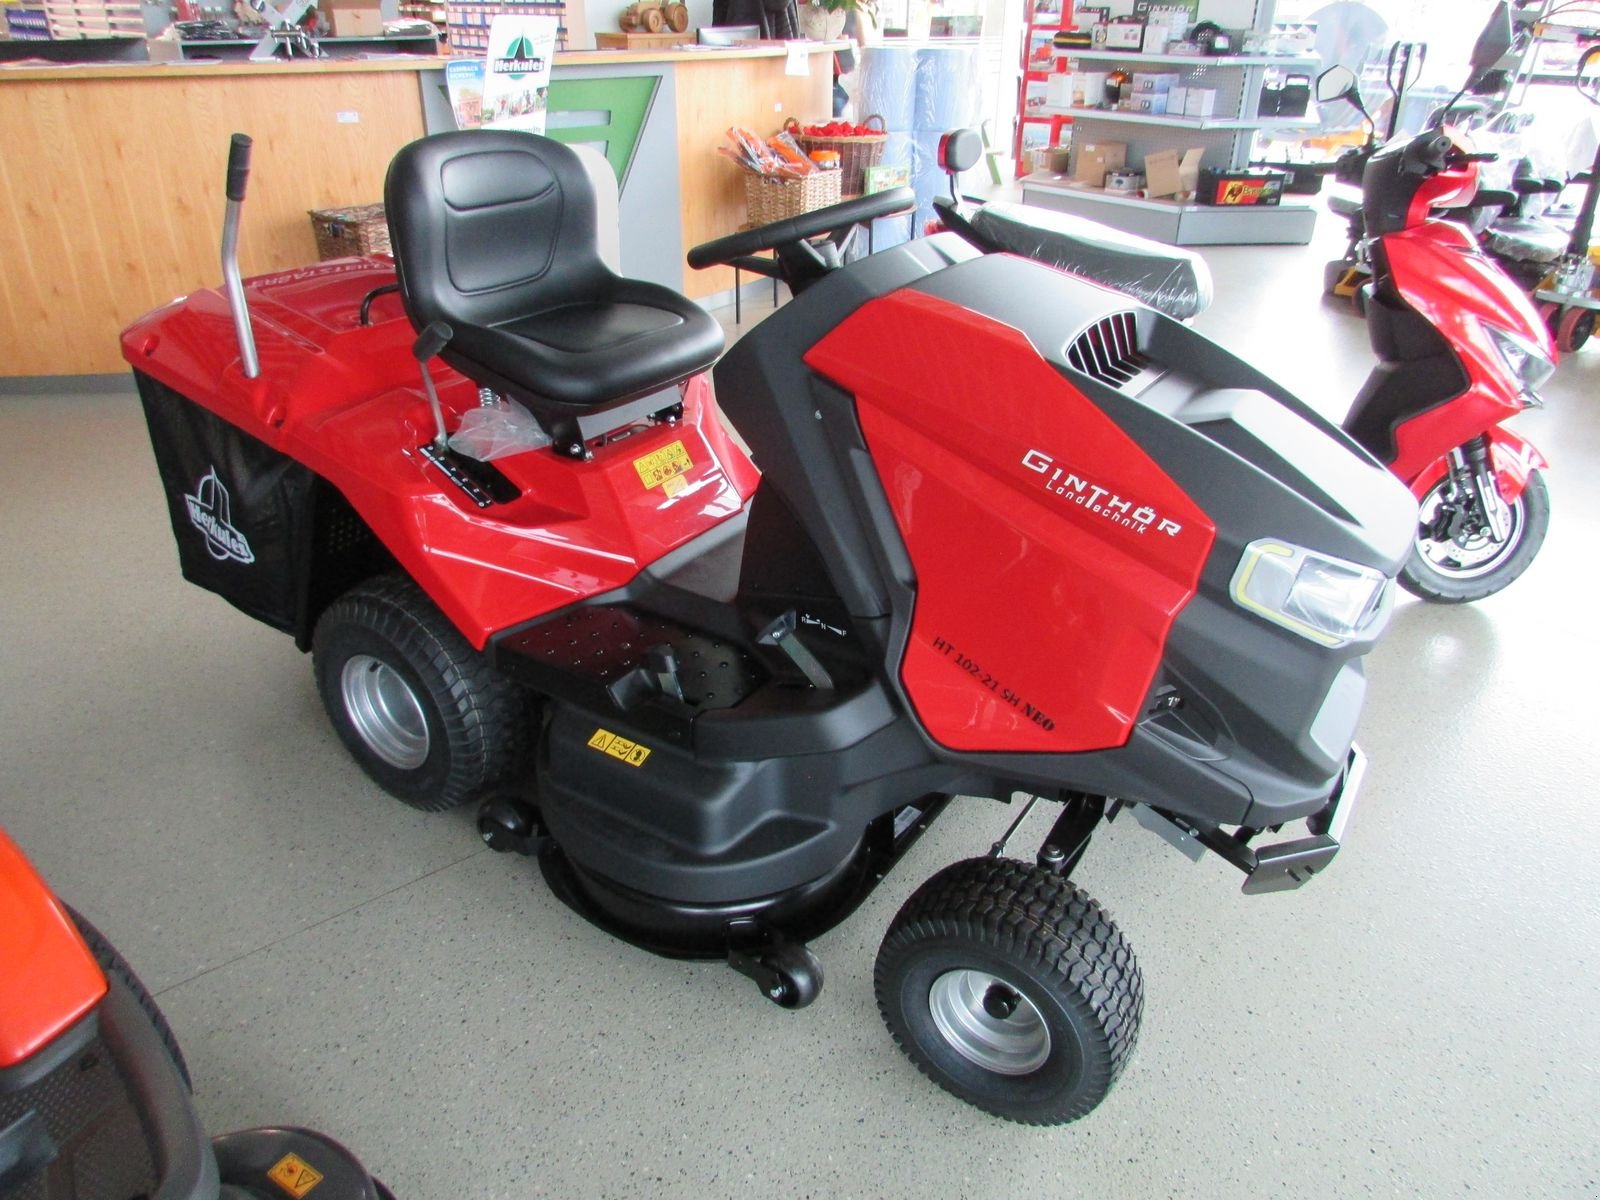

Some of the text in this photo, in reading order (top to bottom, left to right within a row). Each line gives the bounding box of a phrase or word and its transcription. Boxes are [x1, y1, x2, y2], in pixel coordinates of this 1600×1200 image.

[495, 60, 543, 72] Herkules
[188, 500, 250, 558] Herkules
[1021, 449, 1182, 537] GINTHÖR
[932, 636, 1055, 731] HT 102-21 SH NEO
